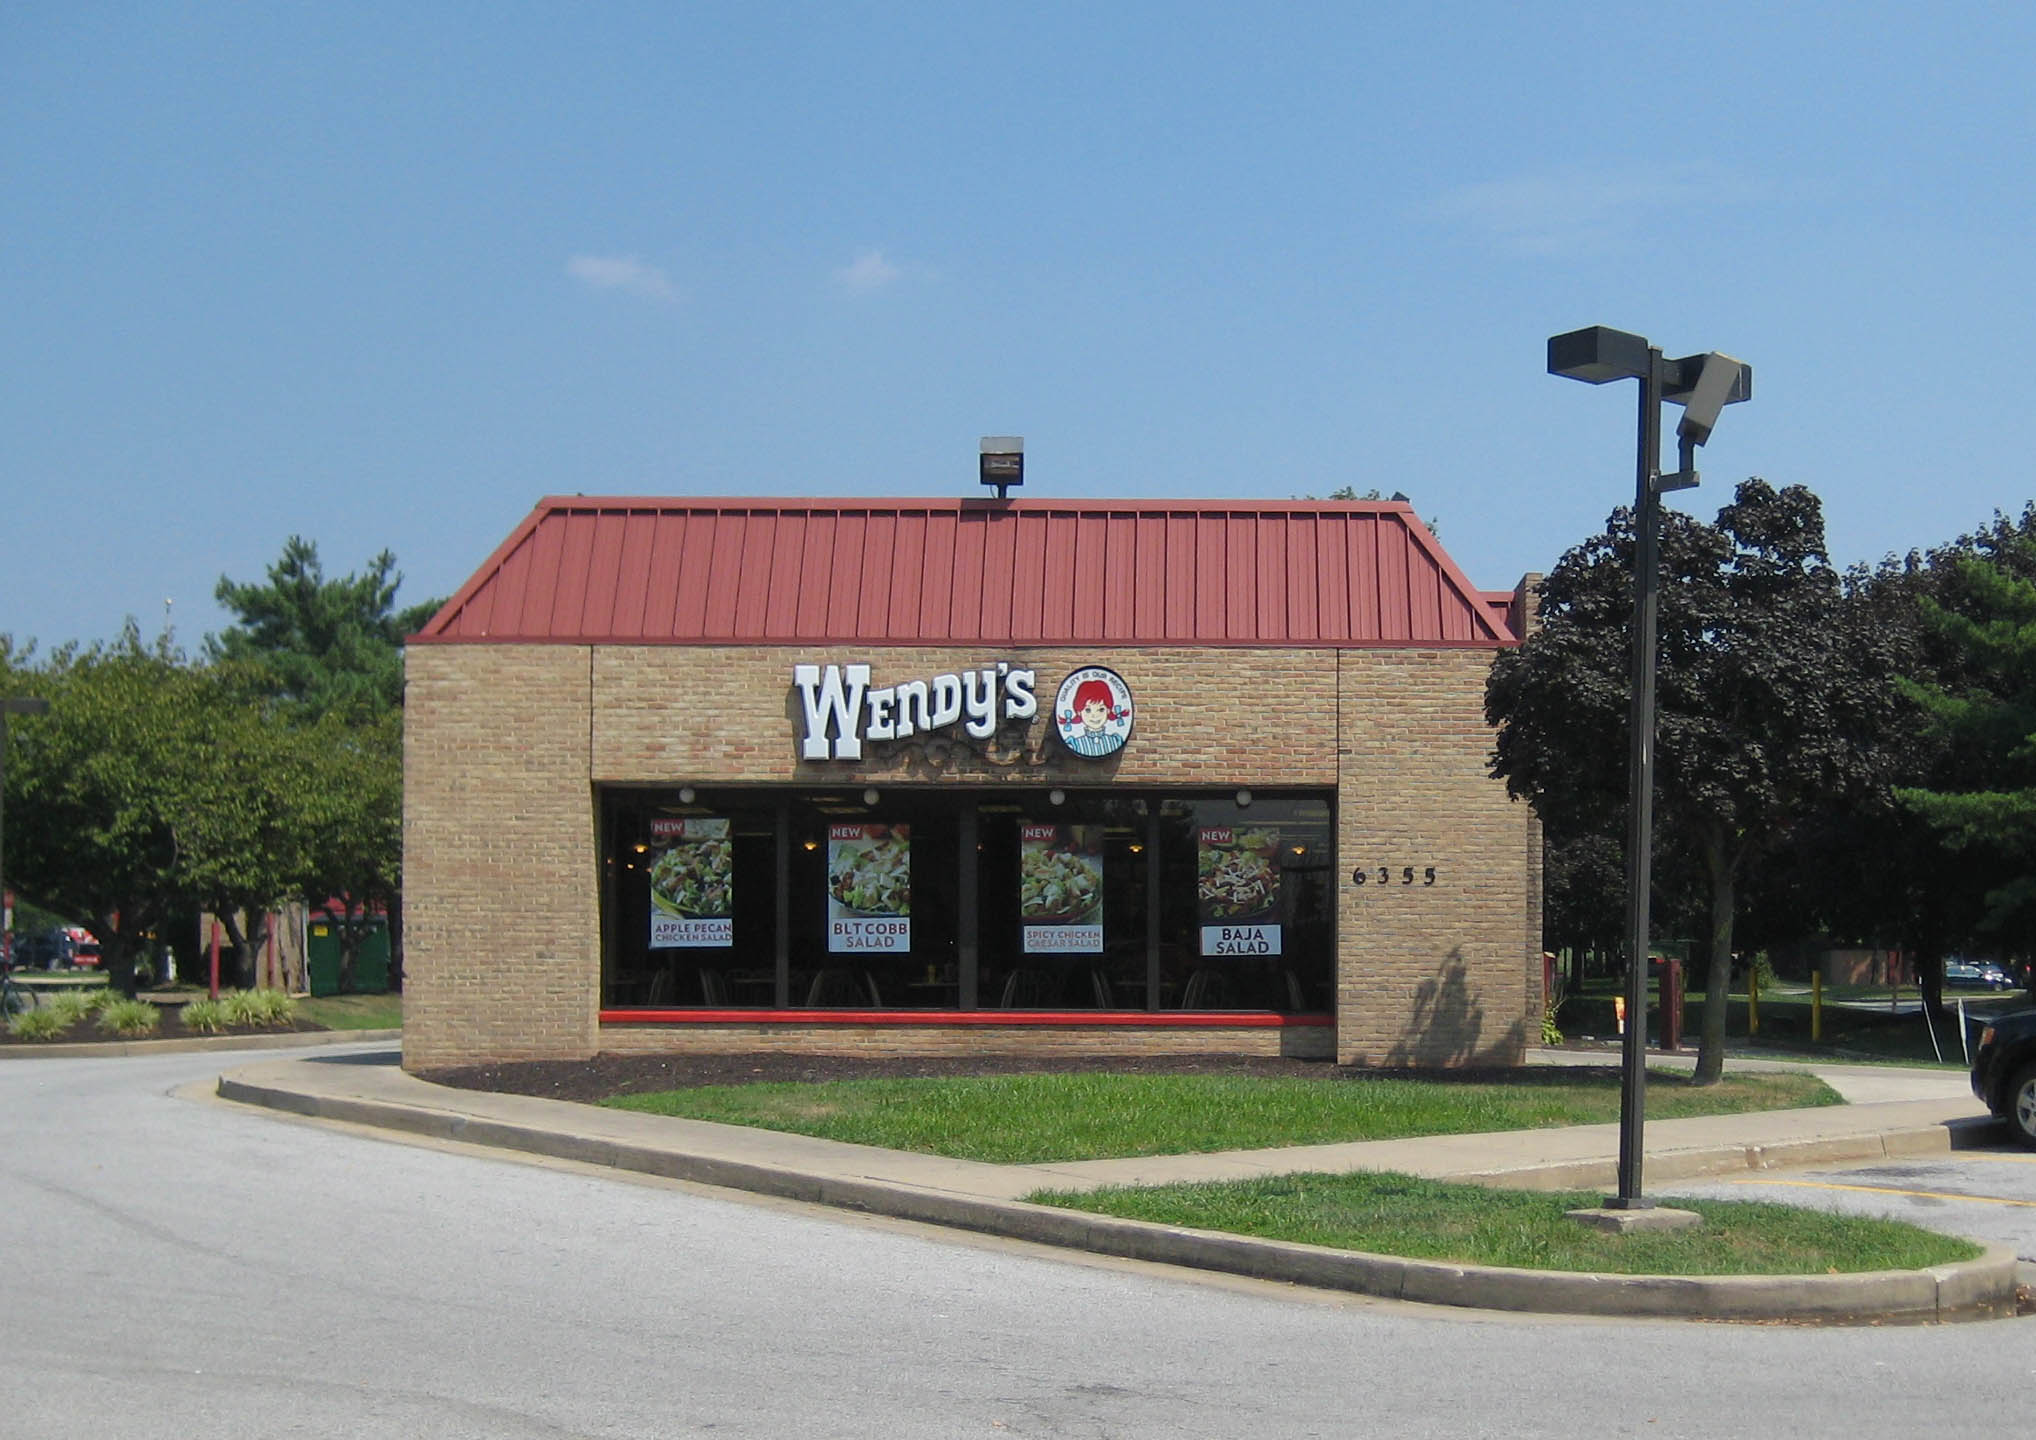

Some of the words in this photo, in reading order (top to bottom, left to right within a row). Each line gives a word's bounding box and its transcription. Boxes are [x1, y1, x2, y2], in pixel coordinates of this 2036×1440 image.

[1060, 675, 1080, 702] QUALITY
[1082, 672, 1090, 680] IS
[1092, 671, 1107, 679] OUR
[1108, 677, 1127, 700] RECIPE
[654, 822, 683, 833] NEW
[832, 827, 861, 838] NEW
[1025, 828, 1054, 838] NEW
[1202, 831, 1230, 841] NEW
[1352, 866, 1436, 886] 6355
[656, 924, 690, 933] APPLE
[694, 923, 732, 933] PECAN
[834, 922, 862, 935] BLT
[865, 923, 907, 935] COBB
[655, 933, 699, 941] CHICKEN
[700, 933, 732, 941] SALAD
[1027, 931, 1055, 939] SPICY
[1057, 931, 1100, 939] CHICKEN
[1222, 928, 1264, 941] BAJA
[846, 936, 895, 948] SALAD
[1027, 939, 1066, 947] CAESAR
[1068, 939, 1100, 947] SALAD
[1216, 941, 1269, 954] SALAD
